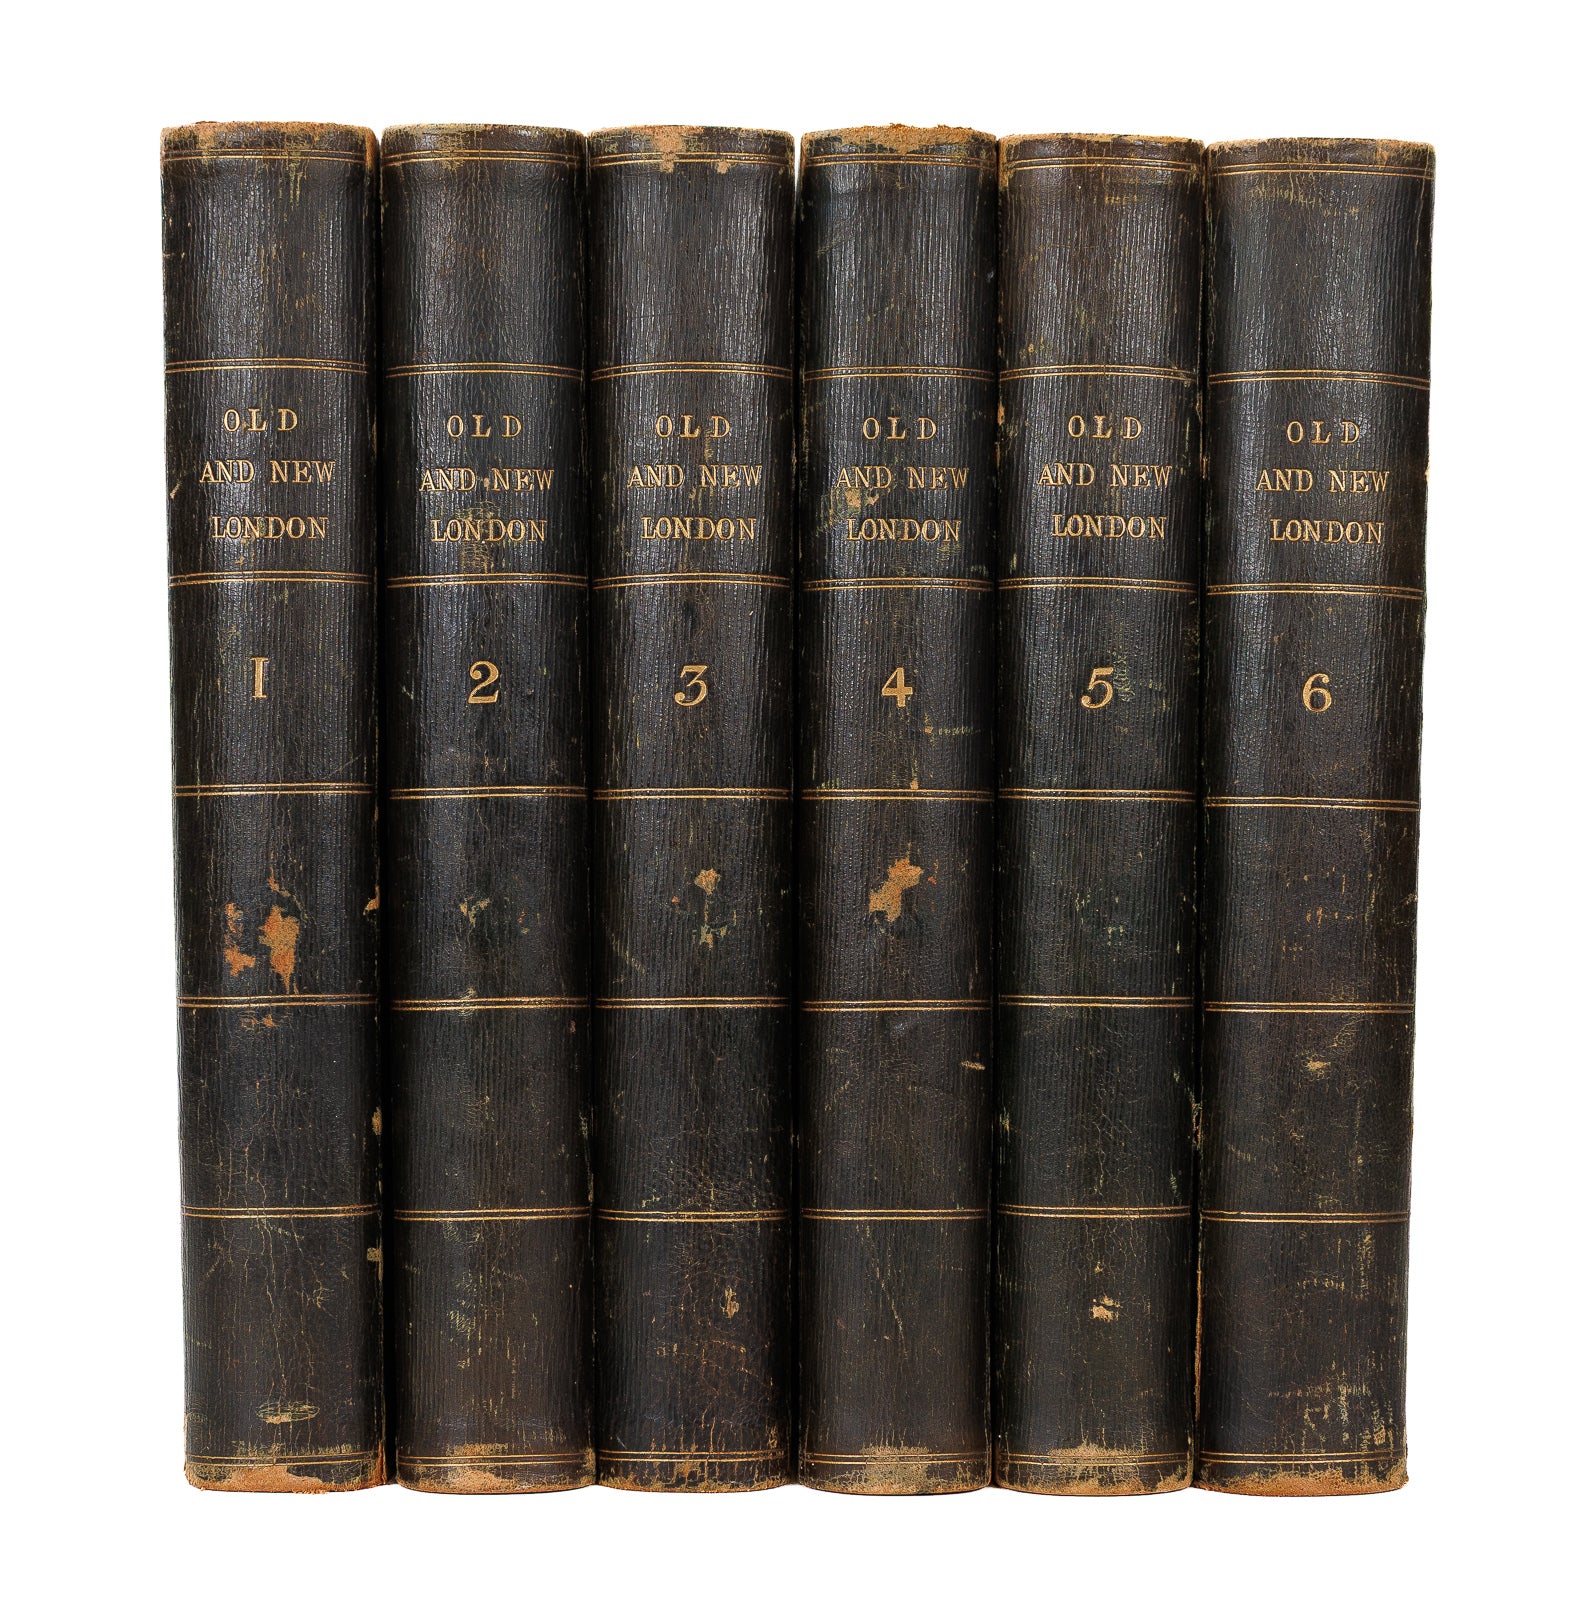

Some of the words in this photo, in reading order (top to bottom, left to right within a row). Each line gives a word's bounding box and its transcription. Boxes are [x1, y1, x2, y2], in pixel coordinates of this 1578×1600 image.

[223, 408, 298, 432] OLD
[447, 414, 522, 438] OLD
[655, 415, 730, 439] OLD
[863, 417, 937, 441] OLD
[1068, 415, 1142, 440] OLD
[1286, 421, 1360, 444] OLD
[200, 460, 255, 484] AND
[270, 460, 335, 483] NEW
[419, 467, 476, 491] AND
[489, 467, 554, 491] NEW
[627, 464, 684, 488] AND
[700, 464, 763, 488] NEW
[836, 466, 892, 489] AND
[907, 466, 969, 489] NEW
[1038, 463, 1095, 487] AND
[1110, 464, 1173, 488] NEW
[1255, 469, 1312, 492] AND
[1329, 470, 1390, 493] NEW
[212, 516, 328, 539] LONDON
[430, 519, 547, 543] LONDON
[641, 517, 756, 541] LONDON
[846, 518, 961, 542] LONDON
[1051, 514, 1166, 540] LONDON
[1270, 519, 1384, 544] LONDON
[468, 660, 499, 704] 2
[674, 665, 707, 707] 3
[881, 667, 913, 707] 4
[1081, 667, 1114, 710] 5
[1302, 673, 1332, 713] 6
